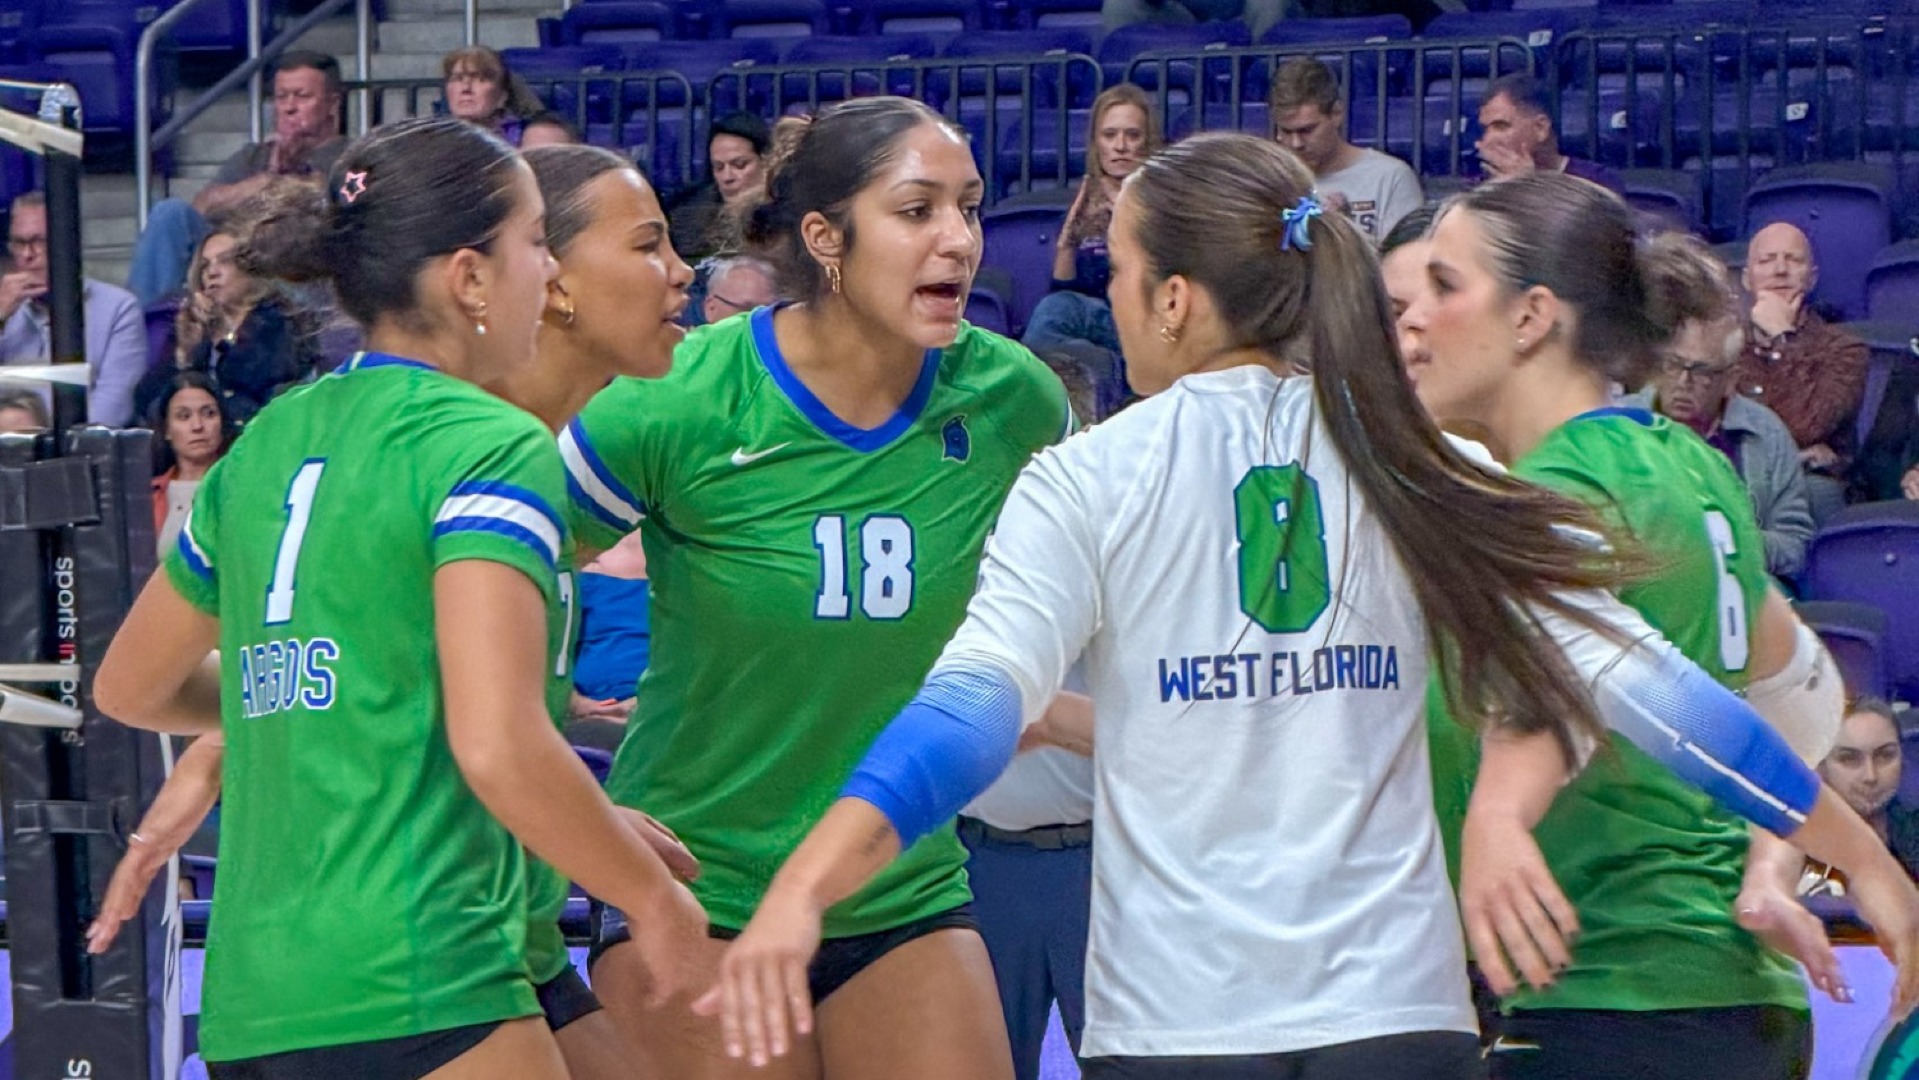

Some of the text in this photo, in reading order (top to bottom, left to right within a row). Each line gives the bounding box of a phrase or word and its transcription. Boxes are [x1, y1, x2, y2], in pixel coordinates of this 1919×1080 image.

[263, 457, 327, 626] 1
[812, 513, 917, 621] 18
[1233, 459, 1331, 634] 8
[1704, 506, 1749, 671] 6
[55, 556, 78, 638] sports
[240, 638, 339, 719] ARGOS
[1158, 644, 1399, 703] WEST FLORIDA
